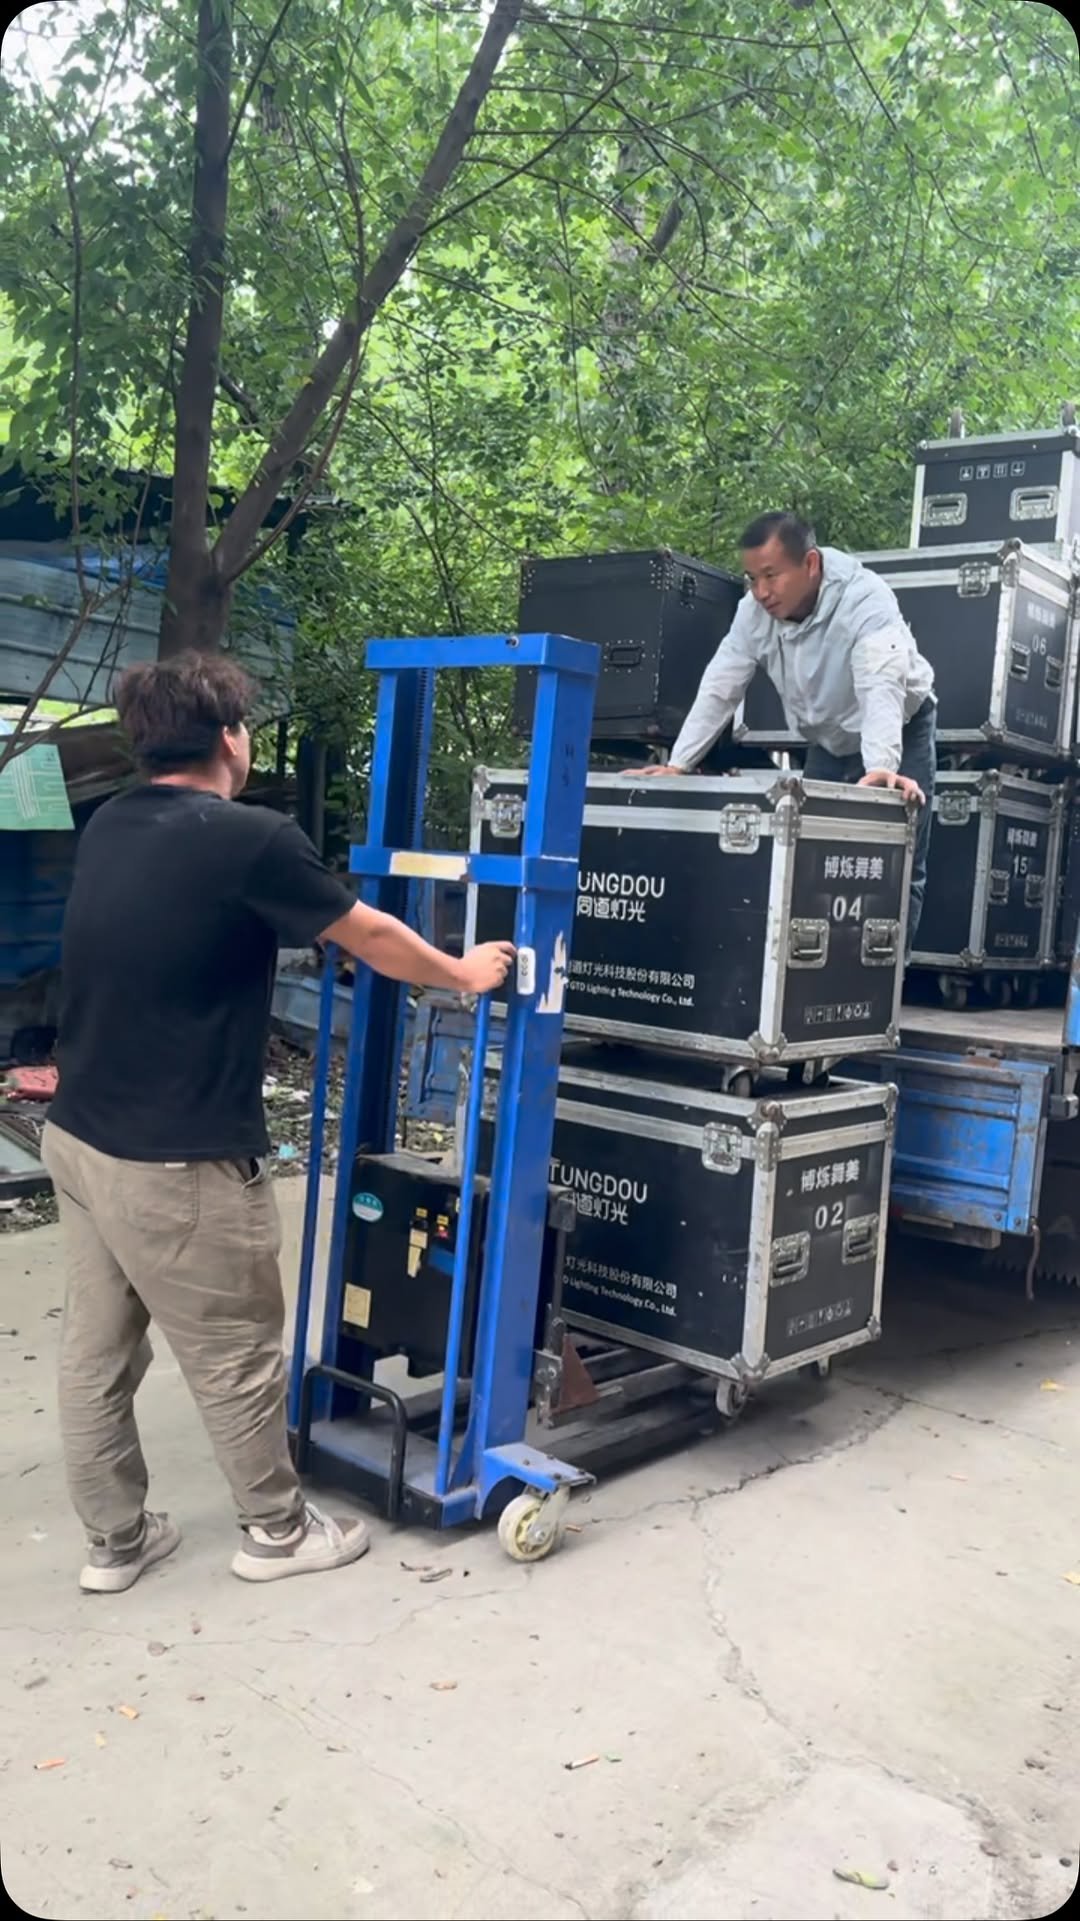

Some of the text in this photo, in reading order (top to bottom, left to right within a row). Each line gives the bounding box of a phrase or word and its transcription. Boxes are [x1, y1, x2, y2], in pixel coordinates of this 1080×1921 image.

[1031, 633, 1047, 656] 06
[1013, 854, 1028, 876] 15
[576, 895, 646, 923] 同道灯光
[832, 895, 863, 921] 04
[567, 960, 695, 990] 道灯光科技股份有限公司
[618, 986, 661, 1004] Technology
[550, 1163, 648, 1204] TUNGDOU
[815, 1200, 844, 1230] 02
[601, 1285, 643, 1308] Technology
